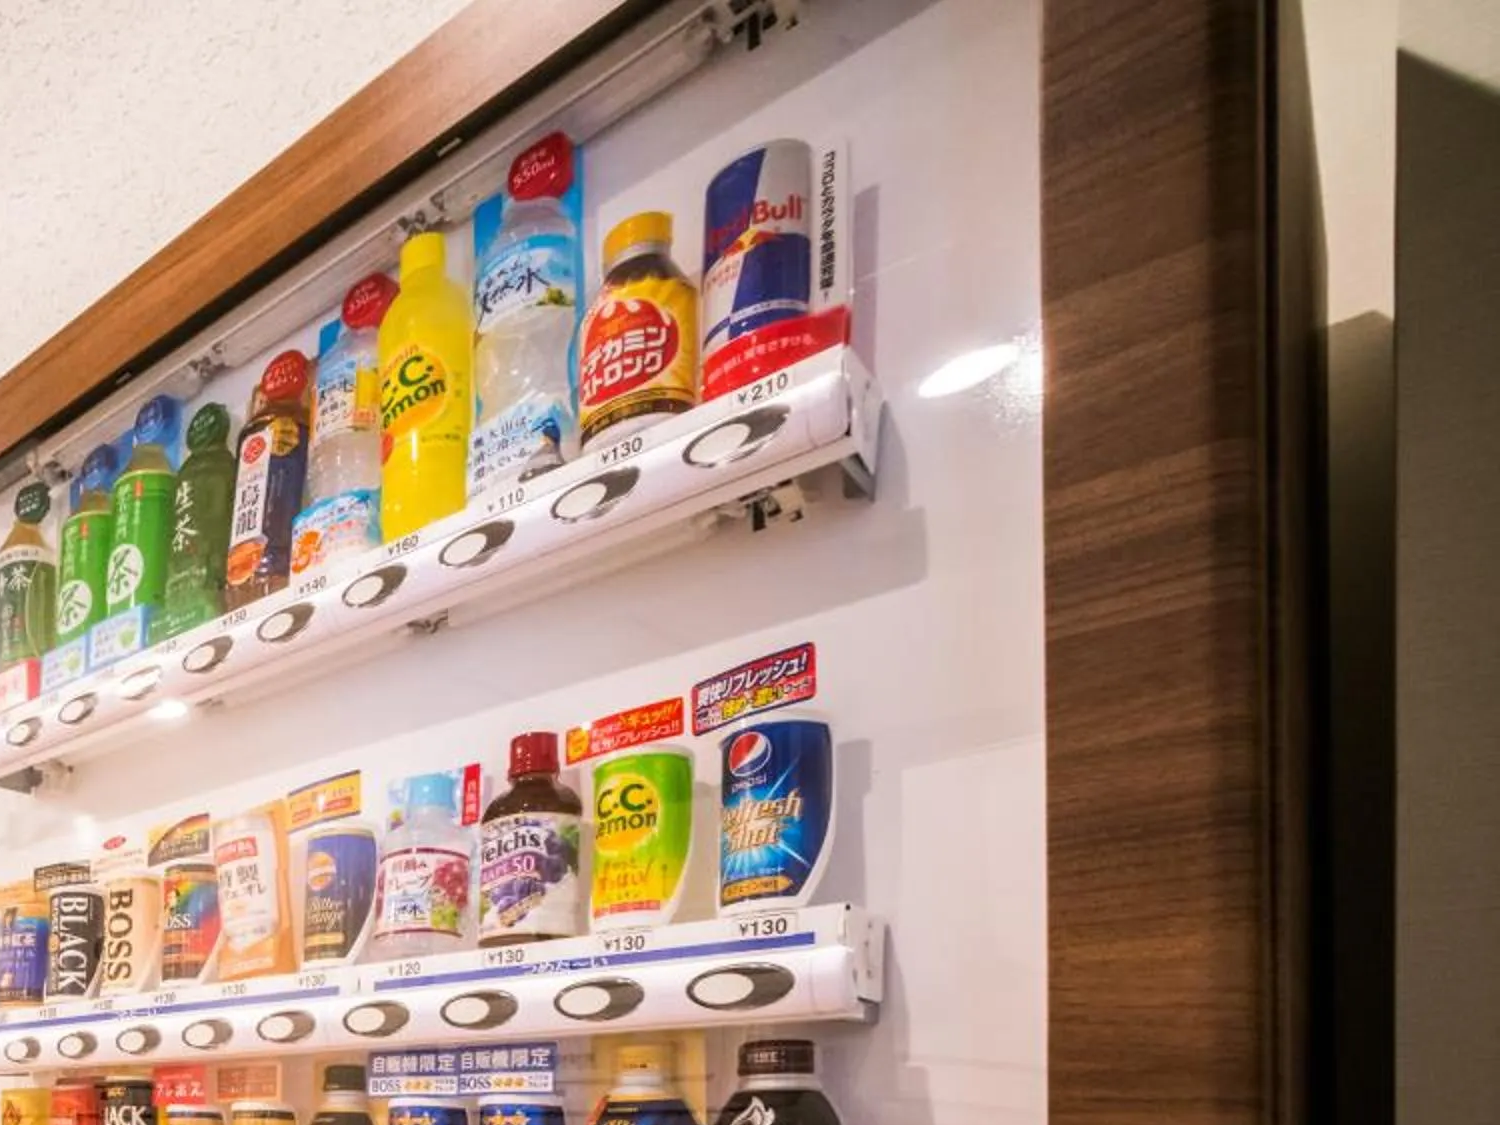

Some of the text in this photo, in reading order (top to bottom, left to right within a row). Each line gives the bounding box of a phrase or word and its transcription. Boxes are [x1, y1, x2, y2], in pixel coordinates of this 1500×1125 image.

[752, 194, 802, 224] Bull
[737, 372, 789, 405] ¥210
[382, 379, 447, 429] emon
[601, 436, 644, 464] ¥130
[173, 480, 199, 552] 生茶
[596, 811, 658, 840] emon
[511, 855, 535, 873] 50
[107, 888, 134, 982] BOSS
[164, 913, 191, 929] OSS
[738, 918, 788, 938] ¥130
[58, 896, 89, 995] BLACK
[488, 949, 524, 965] ¥130
[604, 935, 646, 952] ¥130
[460, 1075, 493, 1090] BOSS
